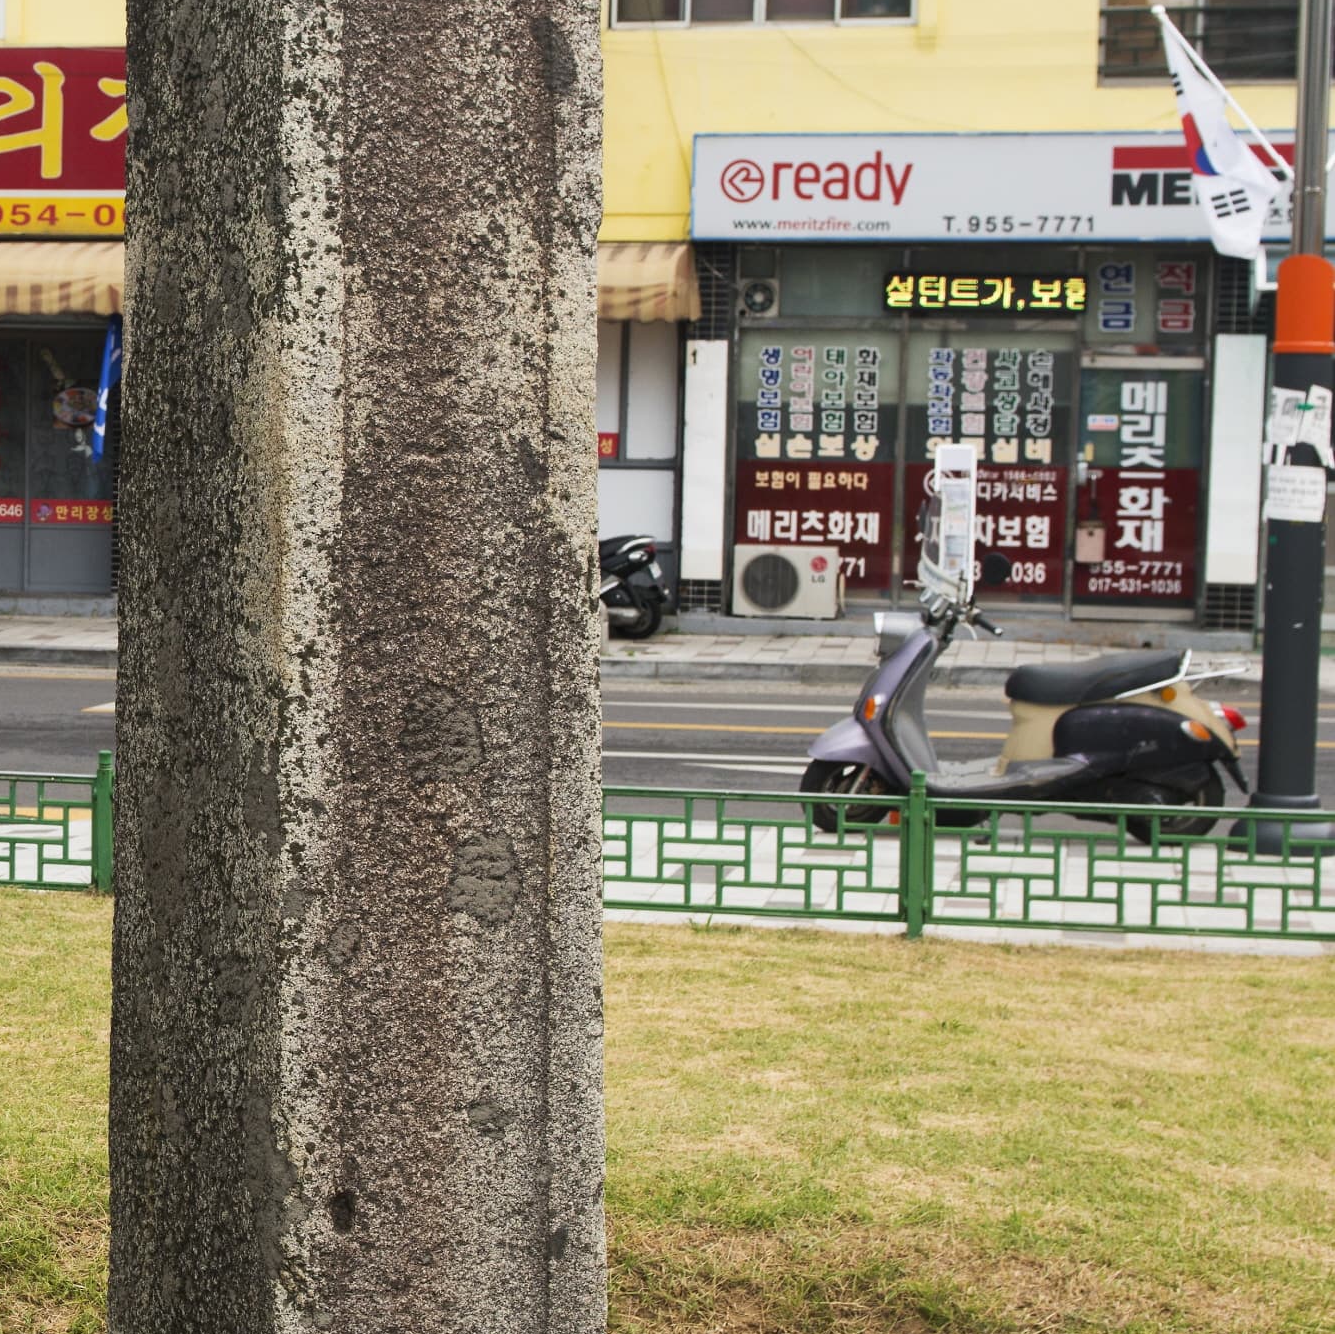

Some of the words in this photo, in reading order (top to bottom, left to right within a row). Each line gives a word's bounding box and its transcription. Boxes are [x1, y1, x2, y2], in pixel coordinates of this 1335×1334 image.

[771, 150, 913, 206] ready
[732, 217, 891, 232] www.meritzfire.com
[968, 215, 1095, 234] 955-7771
[1098, 262, 1134, 333] 연금
[1158, 262, 1196, 333] 적금
[757, 346, 783, 432] 생명보험
[789, 347, 814, 433] 어린이보험
[821, 347, 847, 433] 태아보험
[854, 347, 880, 433] 화재보험
[927, 348, 955, 435] 자동차보험
[993, 348, 1023, 436] 사고상담
[755, 433, 879, 461] 실손보상
[1115, 381, 1171, 553] 메리츠화재
[755, 470, 801, 490] 보험이
[807, 471, 869, 491] 필요하다
[977, 481, 1058, 502] 디카서비스
[747, 509, 880, 545] 메리츠화재
[933, 514, 1051, 549] 차보험
[811, 575, 825, 584] LG
[1088, 577, 1182, 595] 017-531-1036
